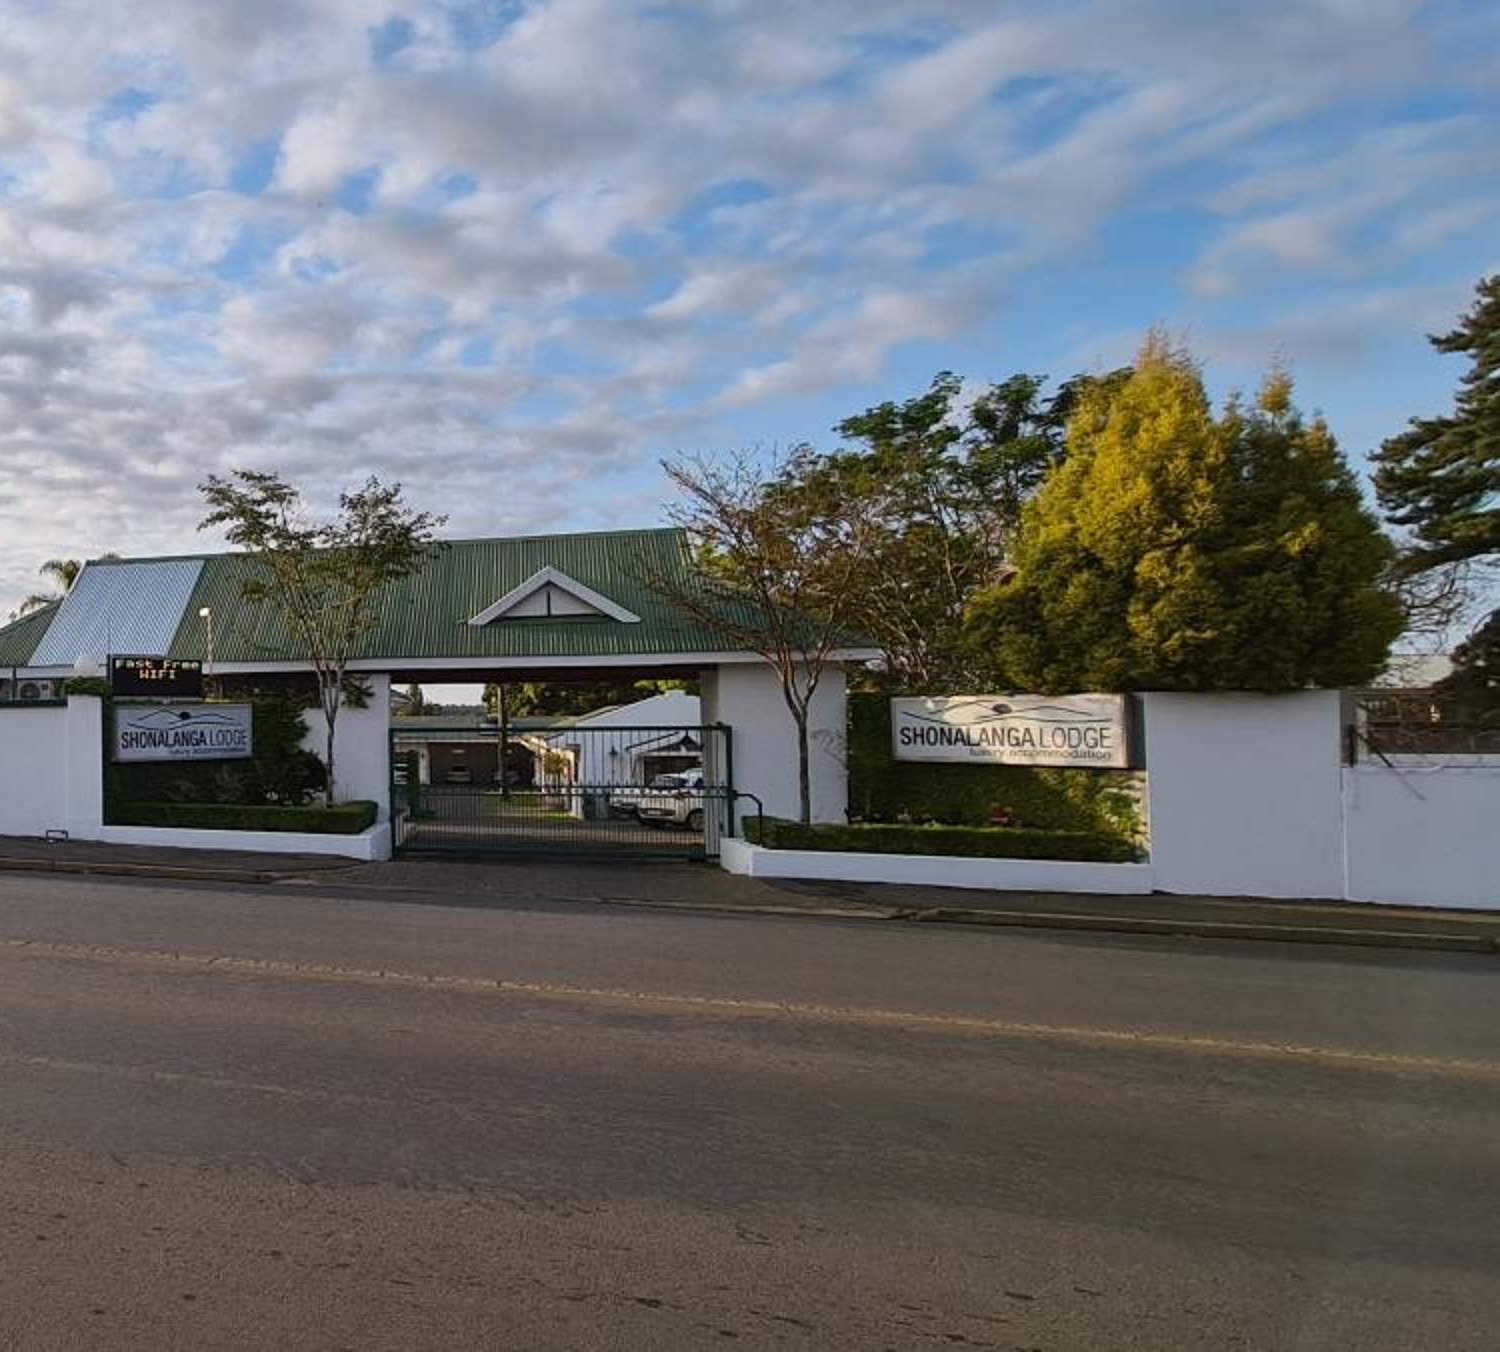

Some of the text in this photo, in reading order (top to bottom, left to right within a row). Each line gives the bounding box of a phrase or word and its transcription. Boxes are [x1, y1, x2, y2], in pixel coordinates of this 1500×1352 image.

[121, 729, 247, 749] SHONALANGA LODGE
[901, 725, 1112, 748] SHONALANGA LODGE
